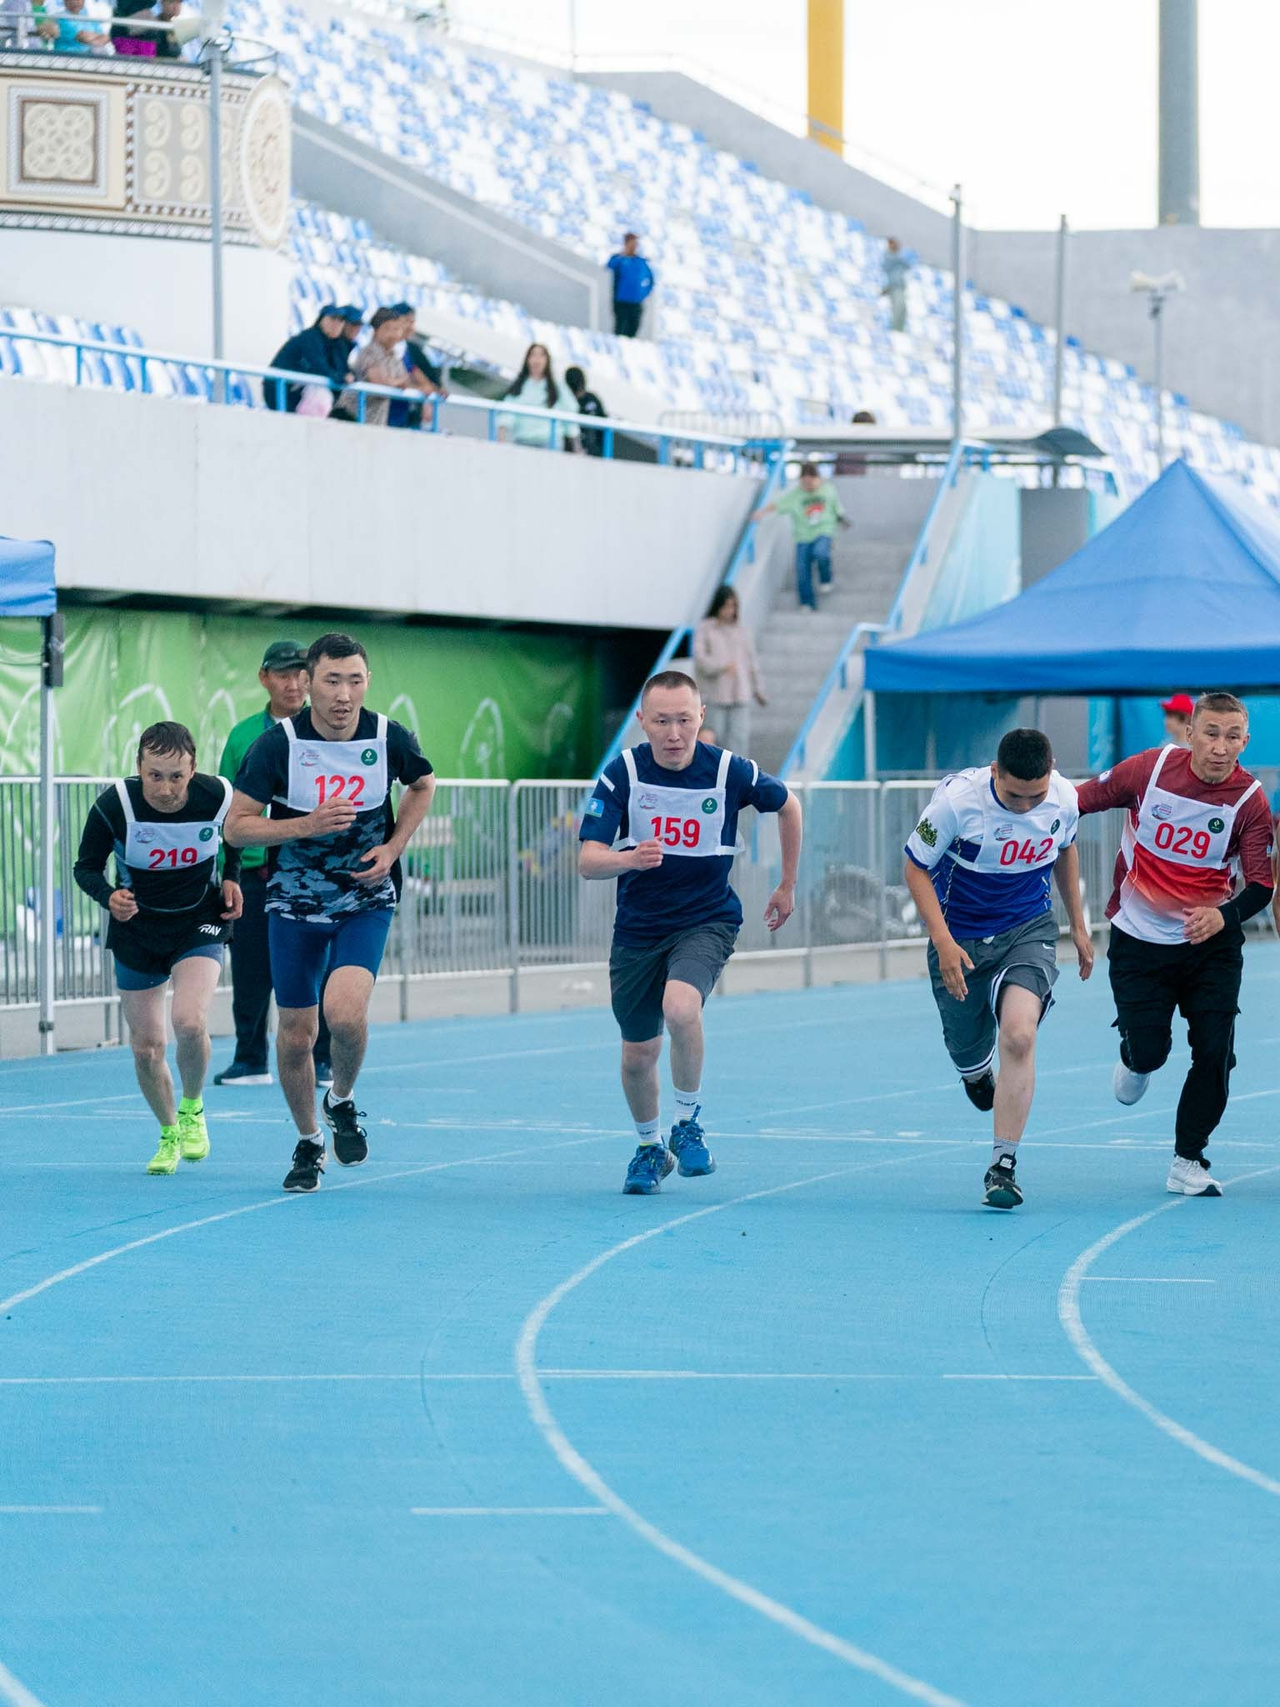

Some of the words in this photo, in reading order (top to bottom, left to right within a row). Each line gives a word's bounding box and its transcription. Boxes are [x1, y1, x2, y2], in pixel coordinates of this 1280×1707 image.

[315, 775, 365, 806] 122
[651, 816, 700, 848] 159
[1154, 823, 1211, 859] 029
[148, 847, 198, 870] 219
[1000, 838, 1054, 866] 042
[198, 924, 222, 936] RAY
